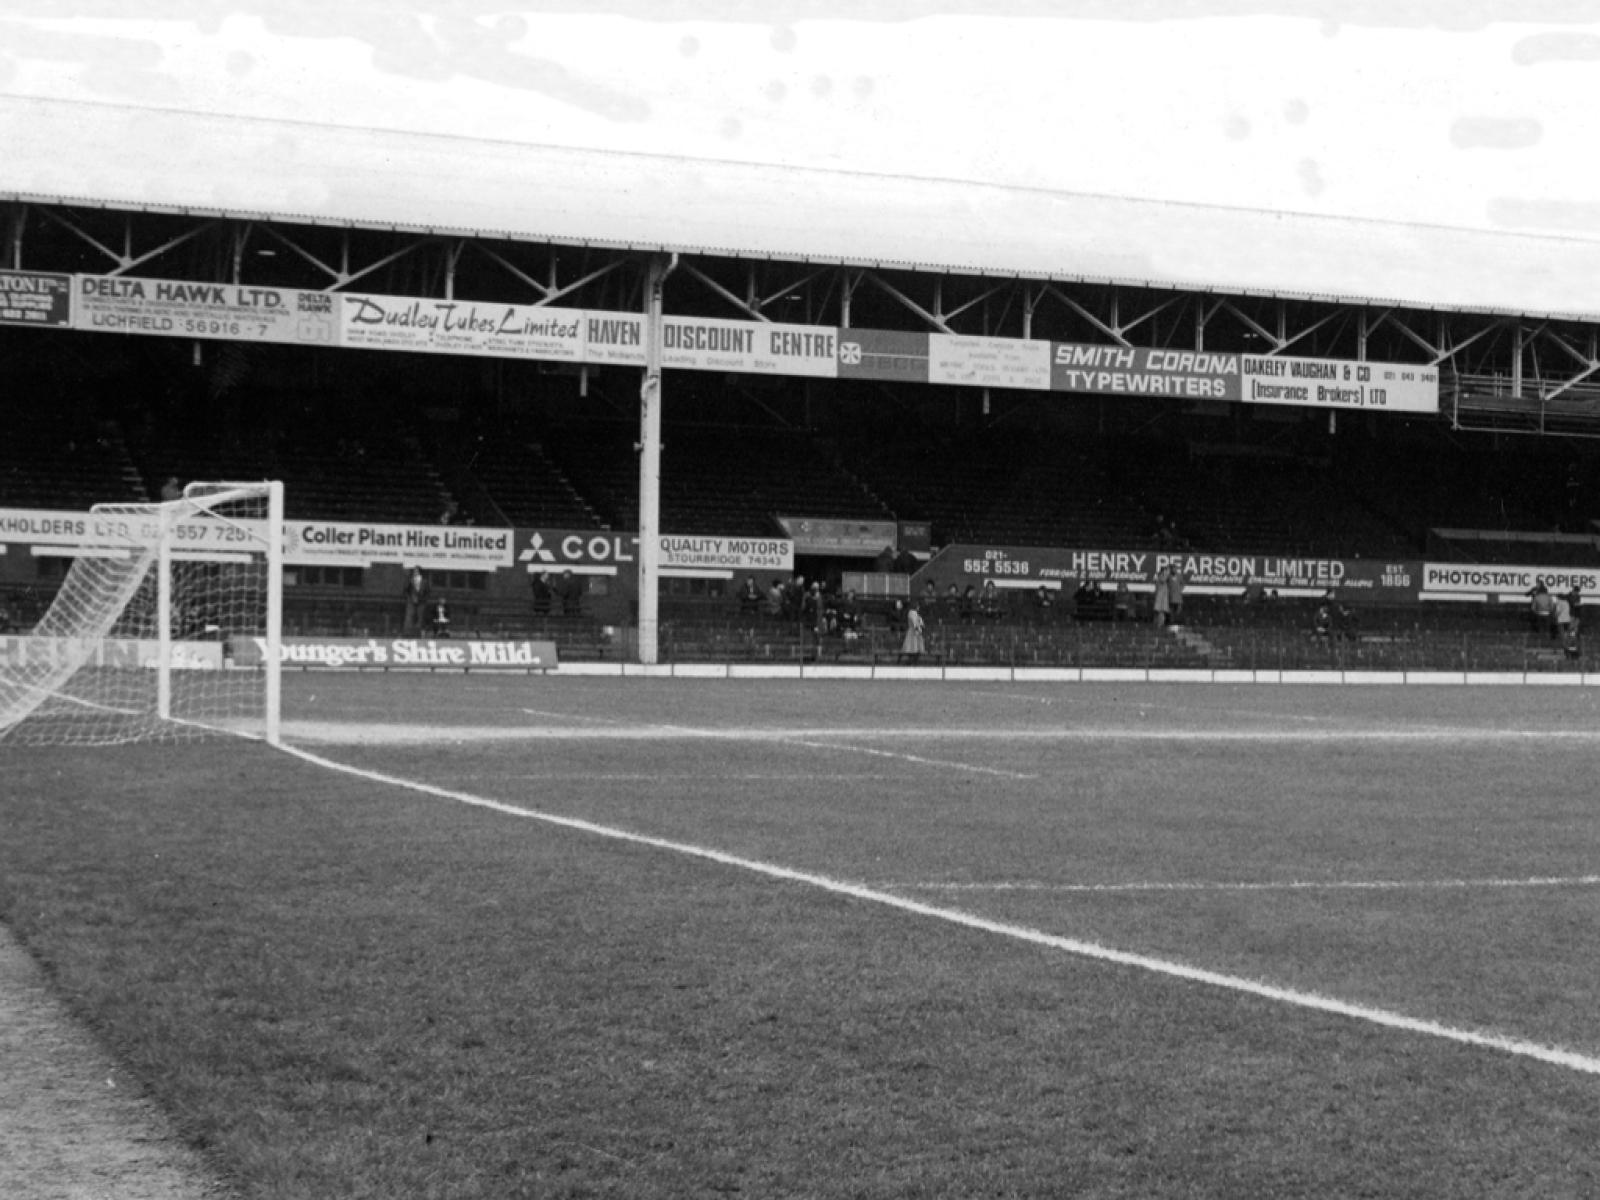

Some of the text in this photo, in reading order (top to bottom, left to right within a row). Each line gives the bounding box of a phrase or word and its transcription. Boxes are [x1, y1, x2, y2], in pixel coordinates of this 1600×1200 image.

[81, 277, 145, 299] DELTA
[156, 283, 225, 305] HAWK
[237, 289, 286, 308] LTD.
[298, 293, 332, 304] DELTA
[297, 303, 332, 313] HAWK
[345, 297, 579, 338] Dudley Tubes Limited
[92, 313, 173, 331] LICHFIELD
[588, 318, 834, 359] HAVEN DISCOUNT CENTRE
[1055, 344, 1136, 368] SMITH
[1146, 351, 1238, 375] CORONA
[1244, 358, 1371, 382] OAKELEY VAUGHAN & CO
[1066, 370, 1226, 397] TYPEWRITERS
[1370, 389, 1387, 405] LTD
[302, 526, 507, 550] Coller Plant Hire Limited
[660, 538, 722, 554] QUALITY
[728, 540, 789, 556] MOTORS
[668, 552, 741, 564] STOURBRIDGE
[1072, 552, 1345, 579] HENRY PEARSON LIMITED
[1428, 569, 1531, 587] PHOTOSTATIC
[392, 640, 465, 664] Shire
[469, 641, 541, 665] Mild.
